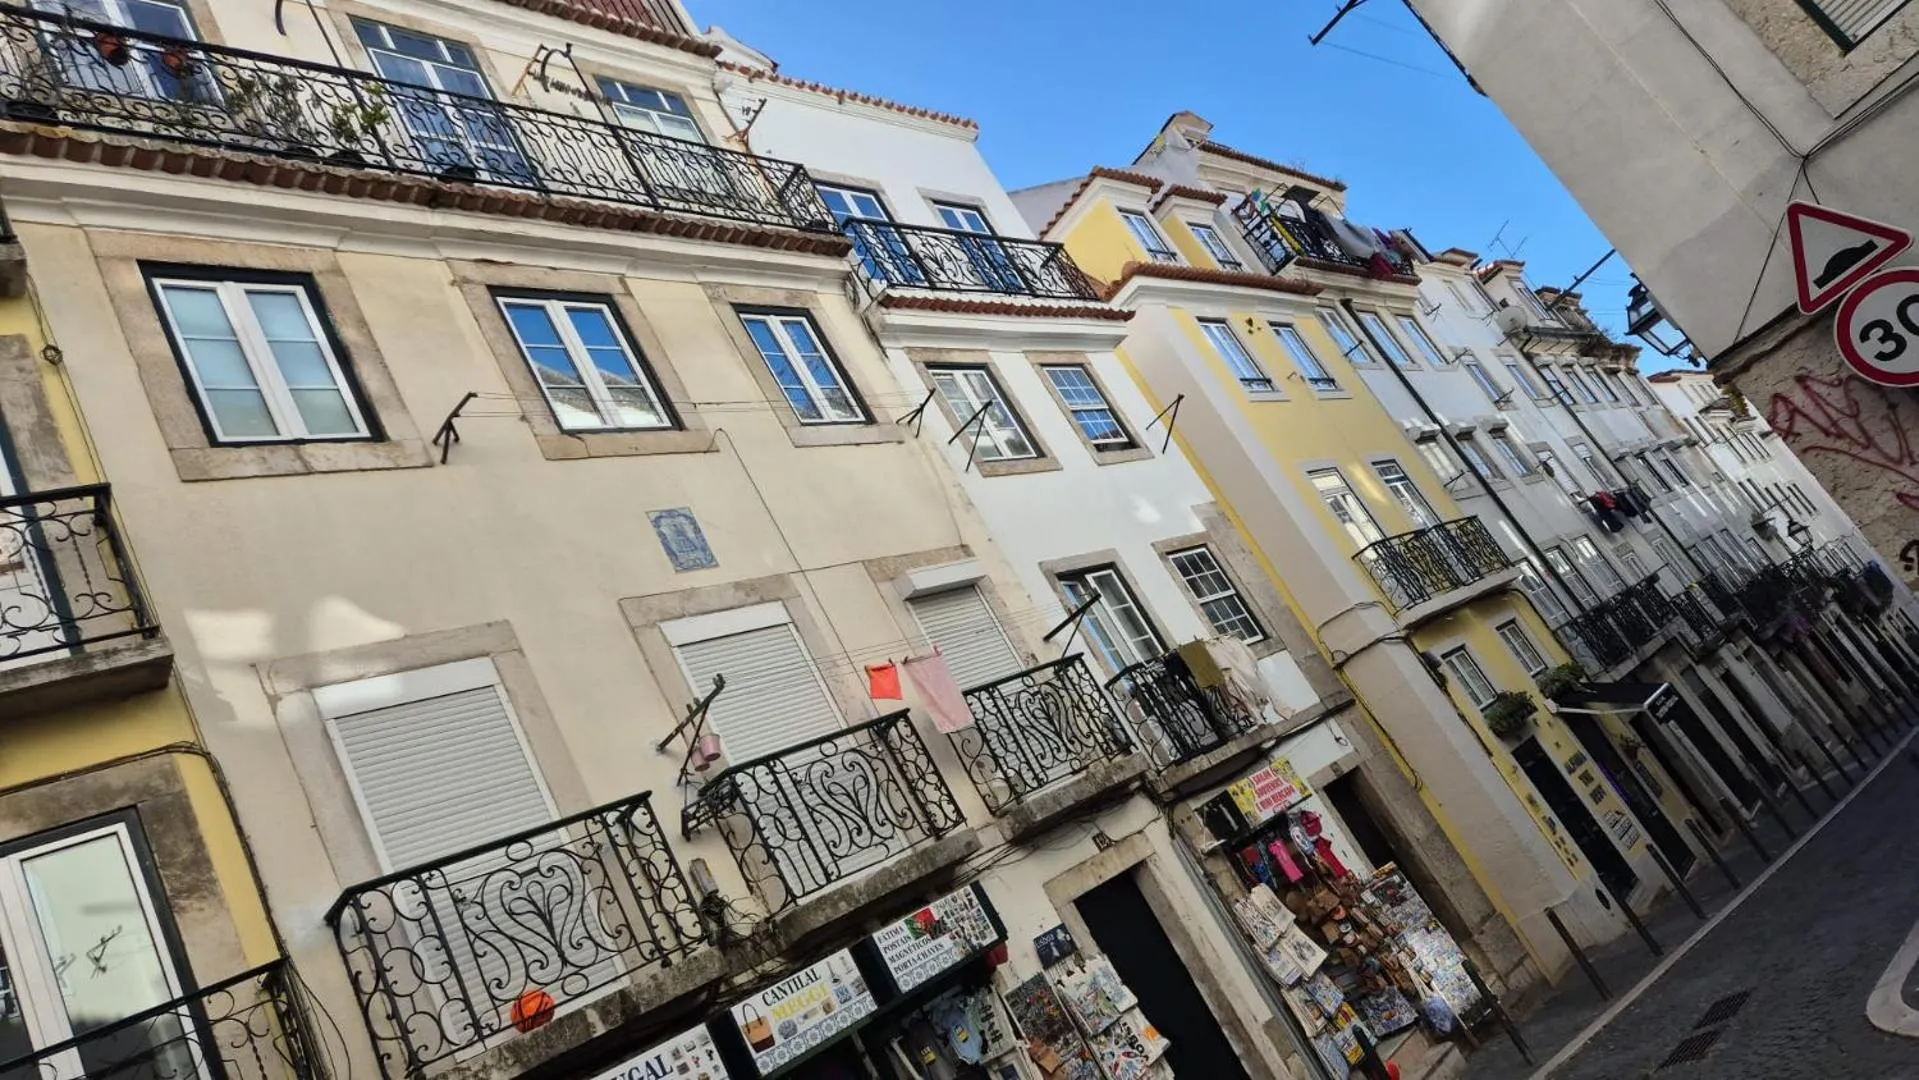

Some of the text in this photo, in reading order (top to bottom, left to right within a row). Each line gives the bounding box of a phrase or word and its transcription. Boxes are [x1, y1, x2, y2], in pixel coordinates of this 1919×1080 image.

[882, 935, 913, 954] POSTAIS
[888, 936, 933, 963] MAGNÉTICOS
[893, 943, 945, 975] PORTA-CHAVES
[762, 967, 821, 1007] CANTILAL
